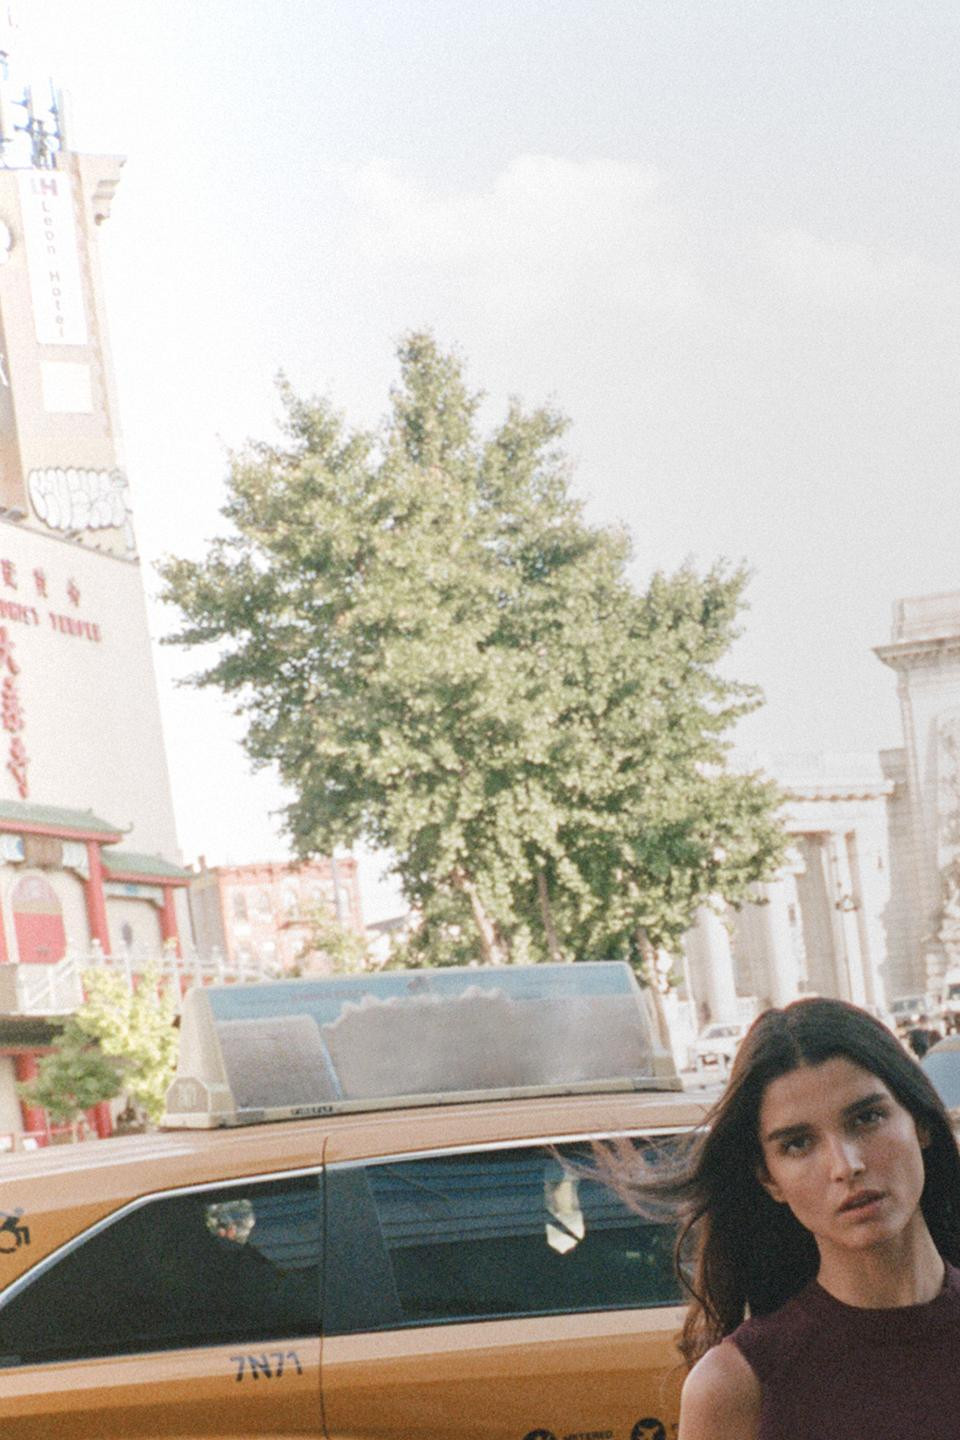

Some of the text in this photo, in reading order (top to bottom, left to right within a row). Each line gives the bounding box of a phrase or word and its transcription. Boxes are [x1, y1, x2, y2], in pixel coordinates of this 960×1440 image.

[42, 200, 65, 338] Leon Hotel
[230, 1351, 303, 1383] 7N71
